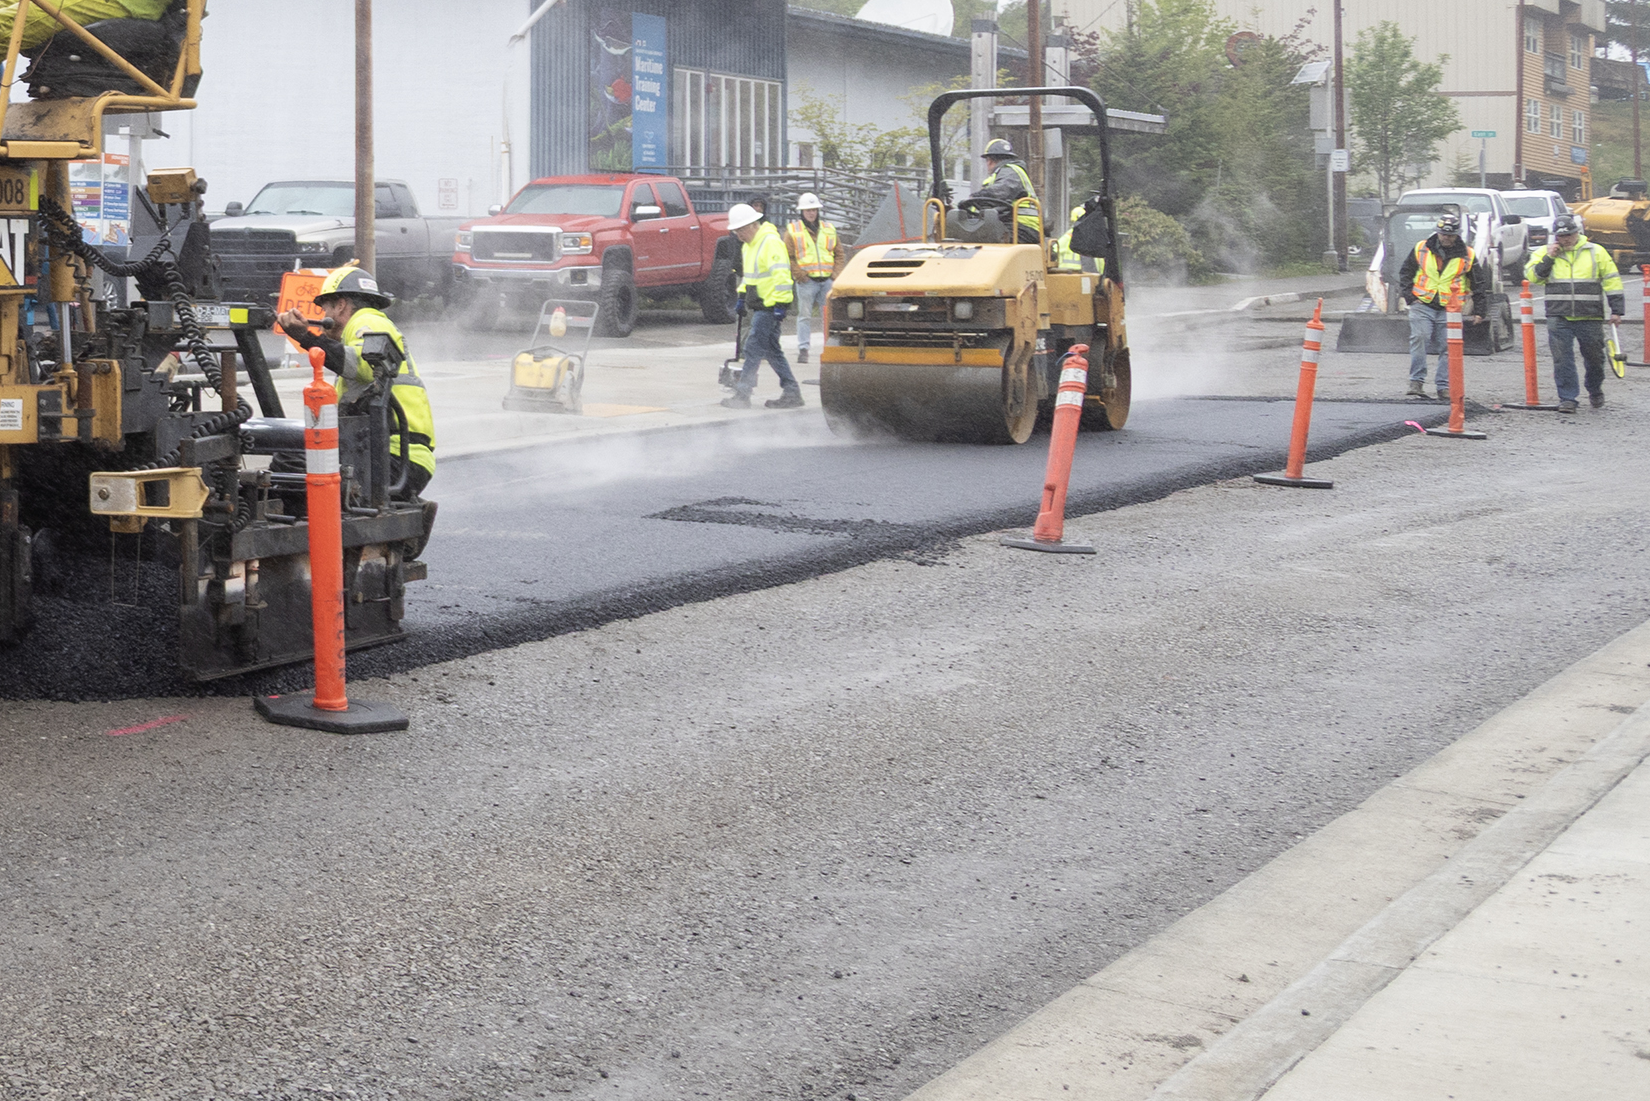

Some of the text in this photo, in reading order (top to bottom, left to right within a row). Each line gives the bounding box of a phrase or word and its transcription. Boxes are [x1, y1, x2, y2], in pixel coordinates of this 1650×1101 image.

[635, 55, 664, 75] Maritime
[635, 75, 661, 97] Training
[635, 95, 657, 113] Center
[284, 298, 324, 316] DETO
